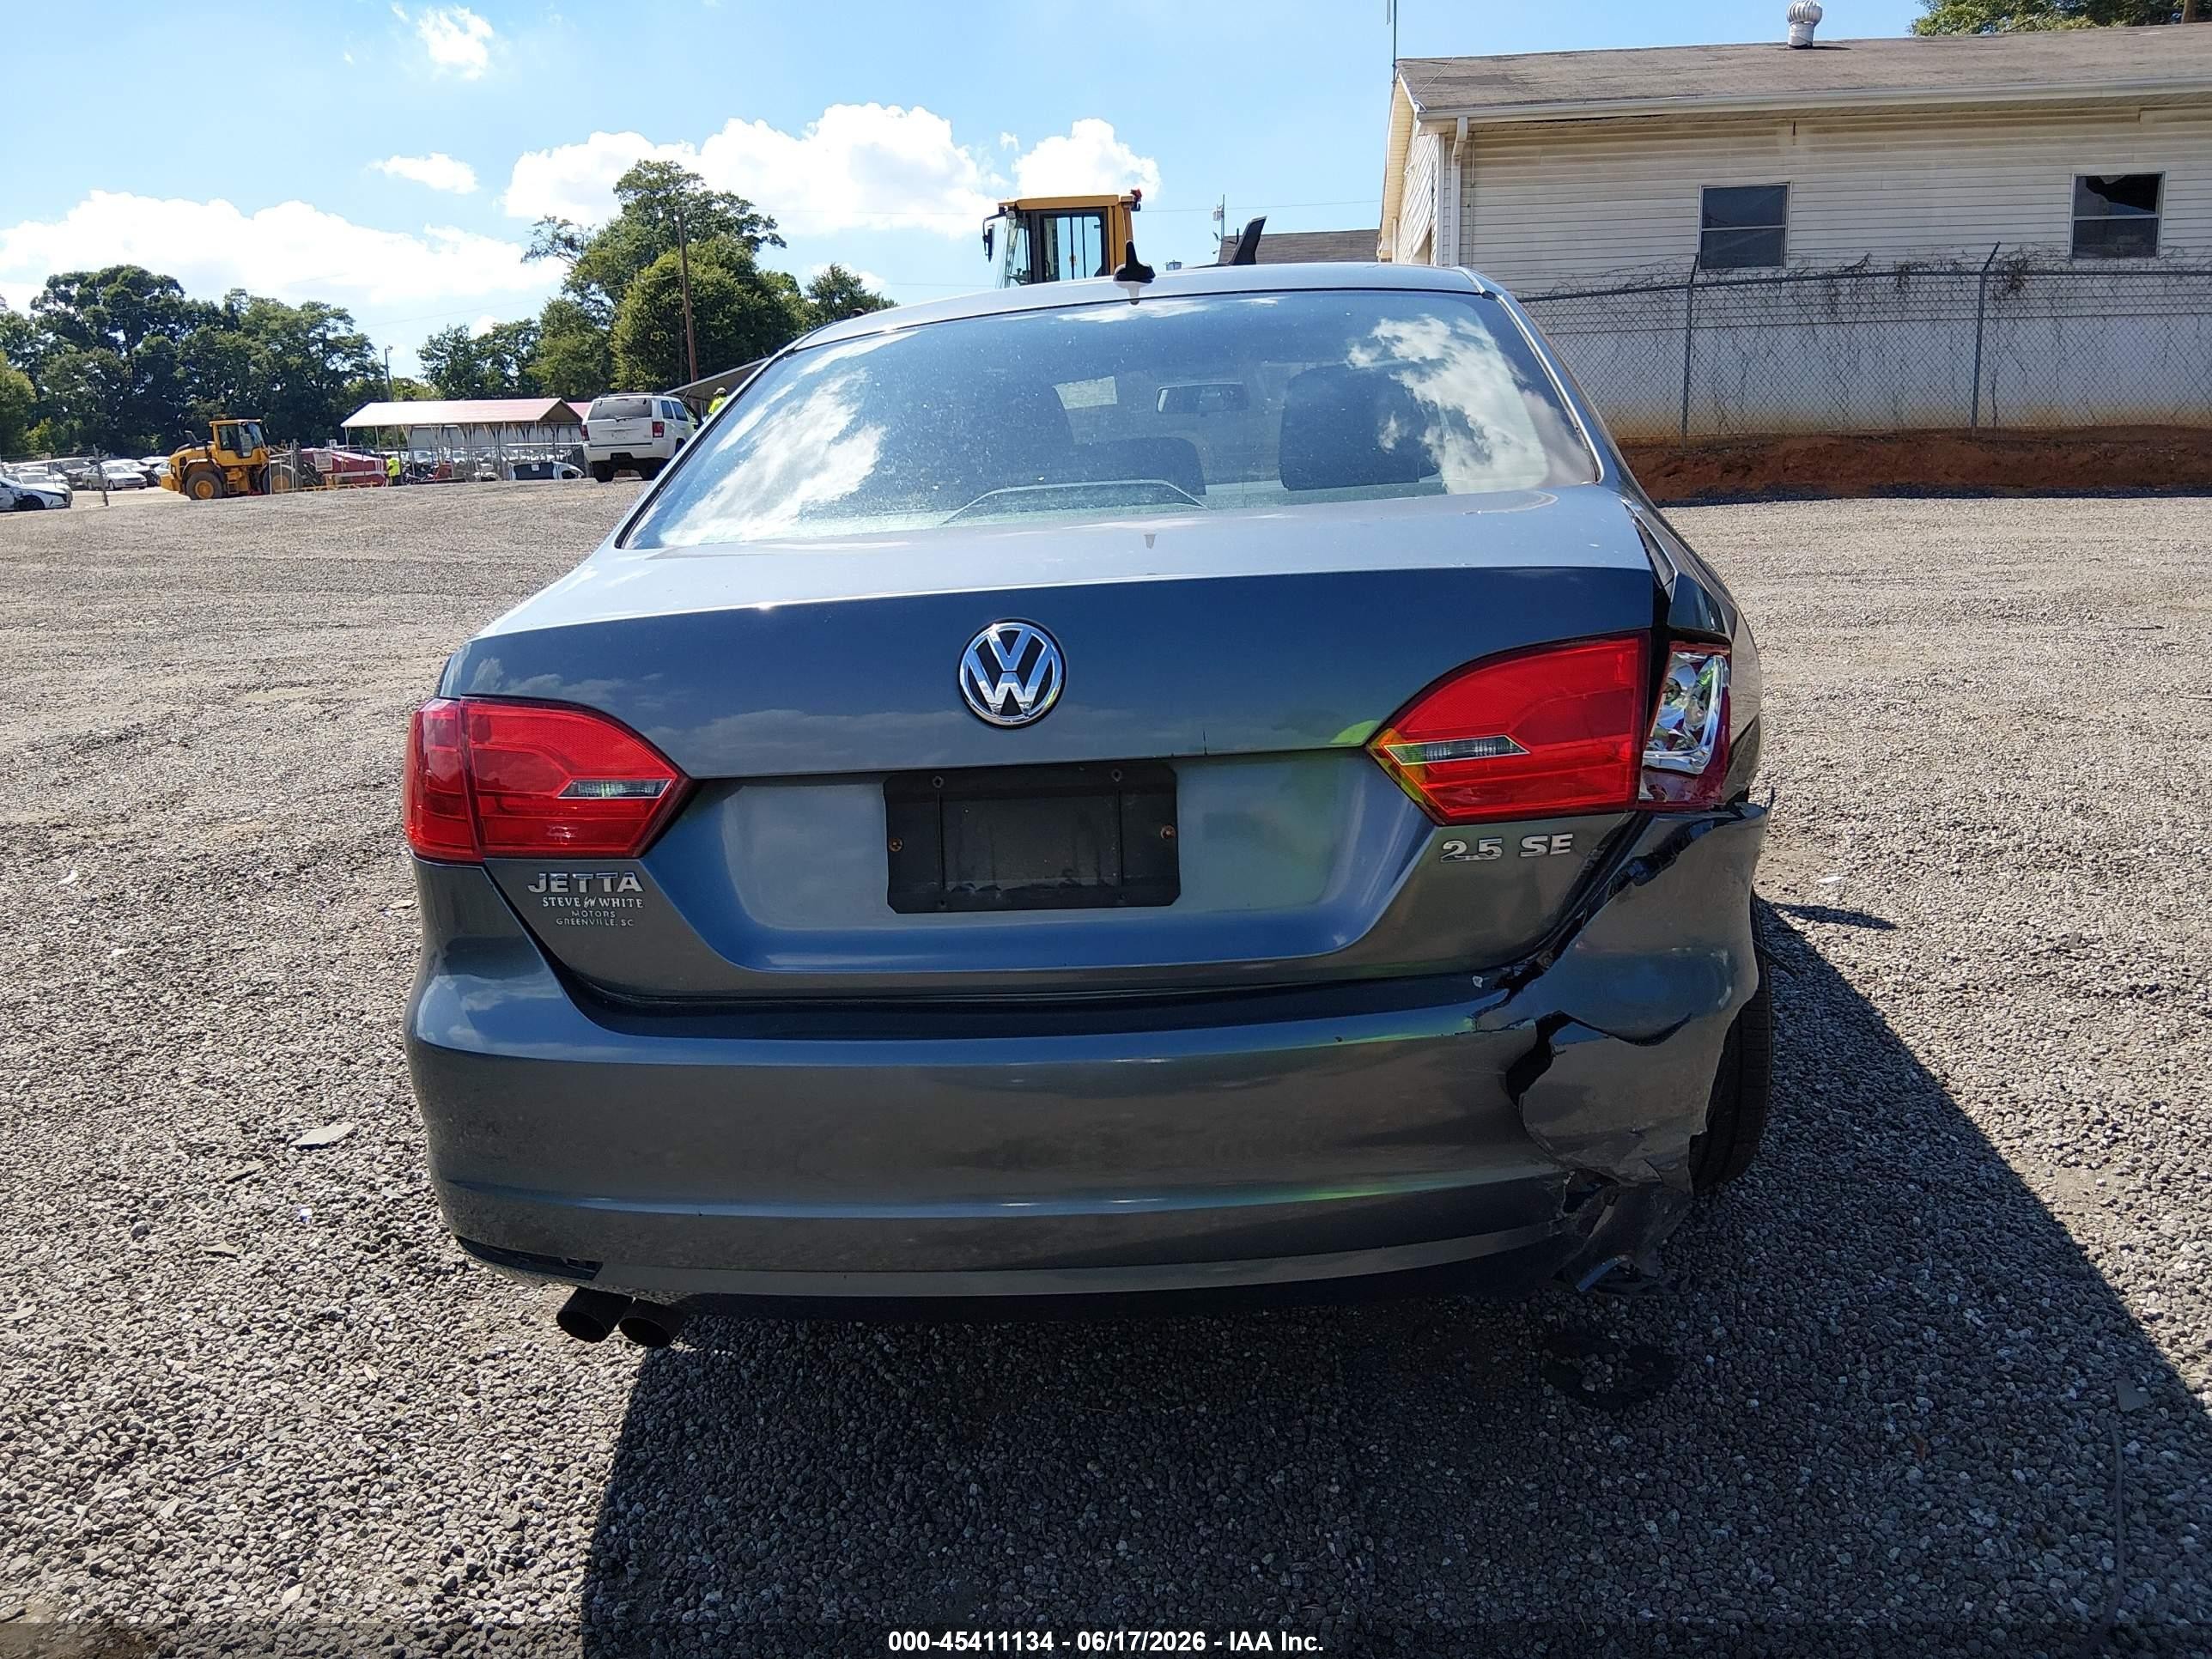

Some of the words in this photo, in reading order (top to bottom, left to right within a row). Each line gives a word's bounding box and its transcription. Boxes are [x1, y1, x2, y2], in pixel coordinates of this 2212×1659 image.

[959, 622, 1064, 726] VW
[1519, 833, 1574, 857] SE
[527, 872, 644, 893] JETTA
[543, 896, 581, 907] STEVE
[599, 897, 644, 908] WHITE
